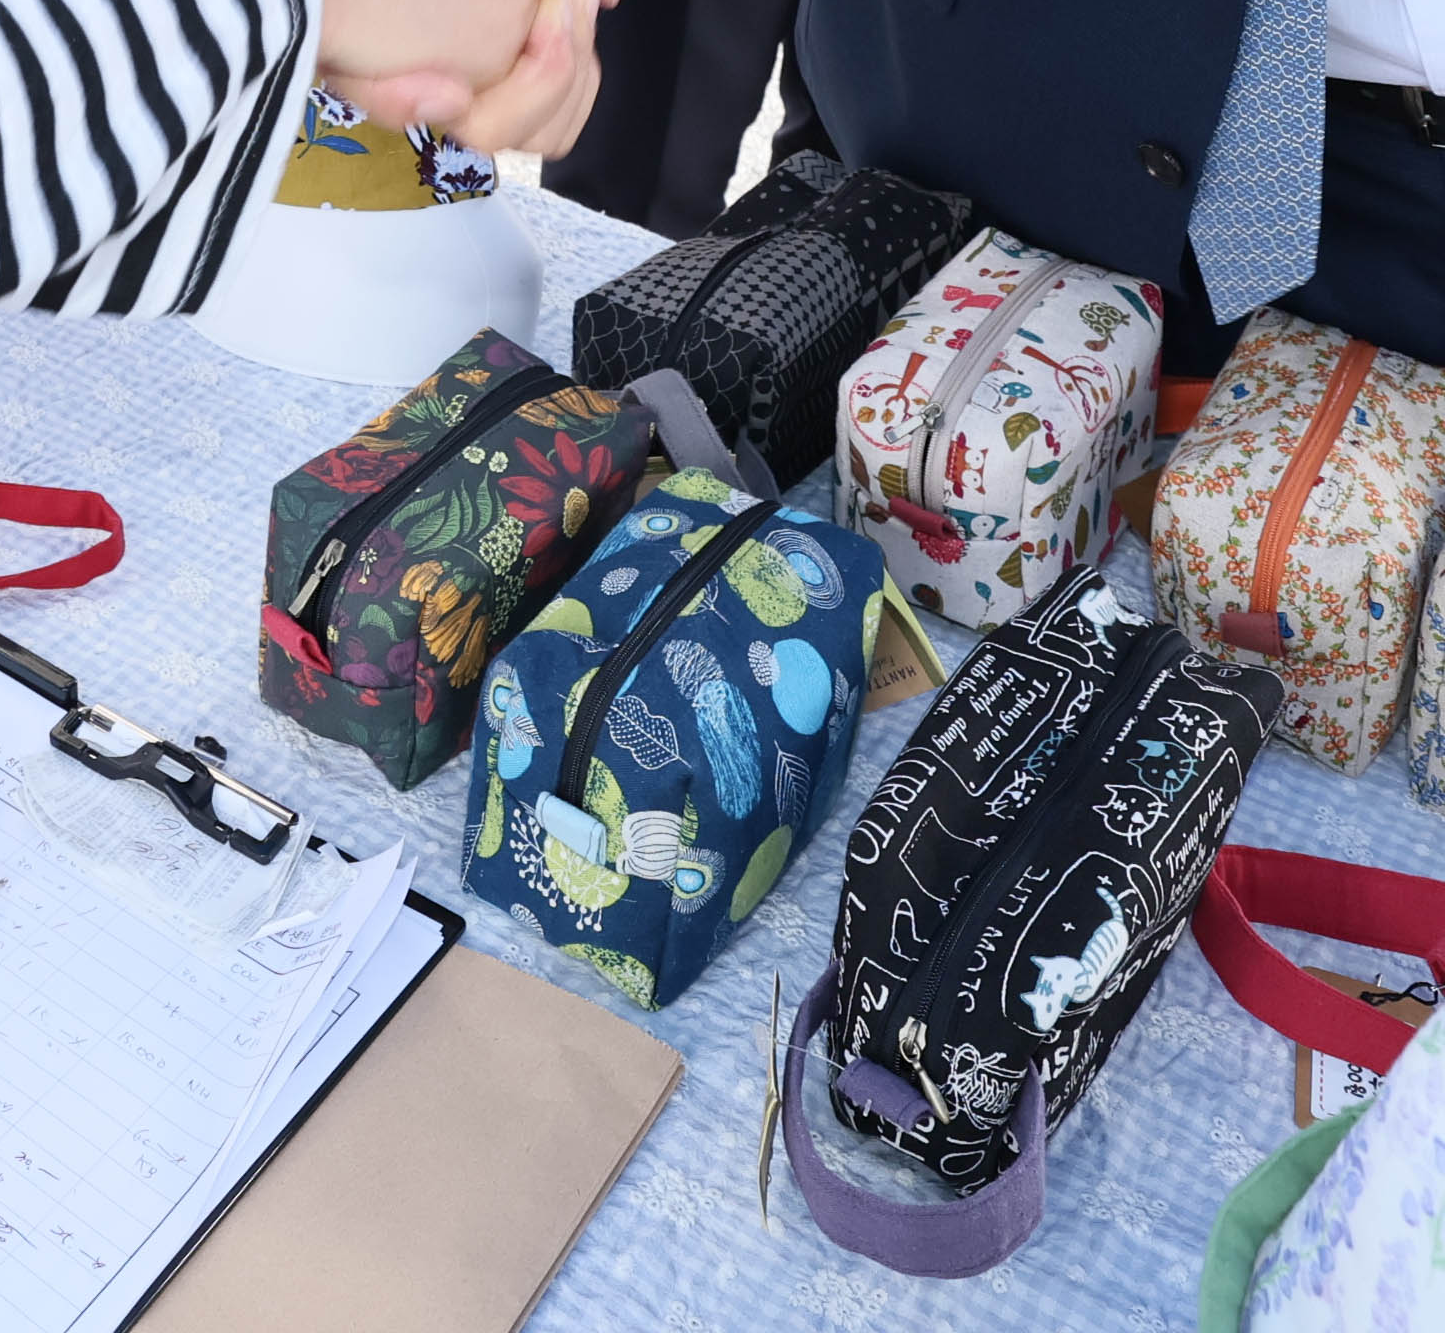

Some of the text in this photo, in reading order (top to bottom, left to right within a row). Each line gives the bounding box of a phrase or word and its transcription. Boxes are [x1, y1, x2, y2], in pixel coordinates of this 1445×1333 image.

[931, 667, 1027, 752] leisurely along
[972, 678, 1051, 762] Trying to live
[1165, 785, 1225, 878] Trying to live
